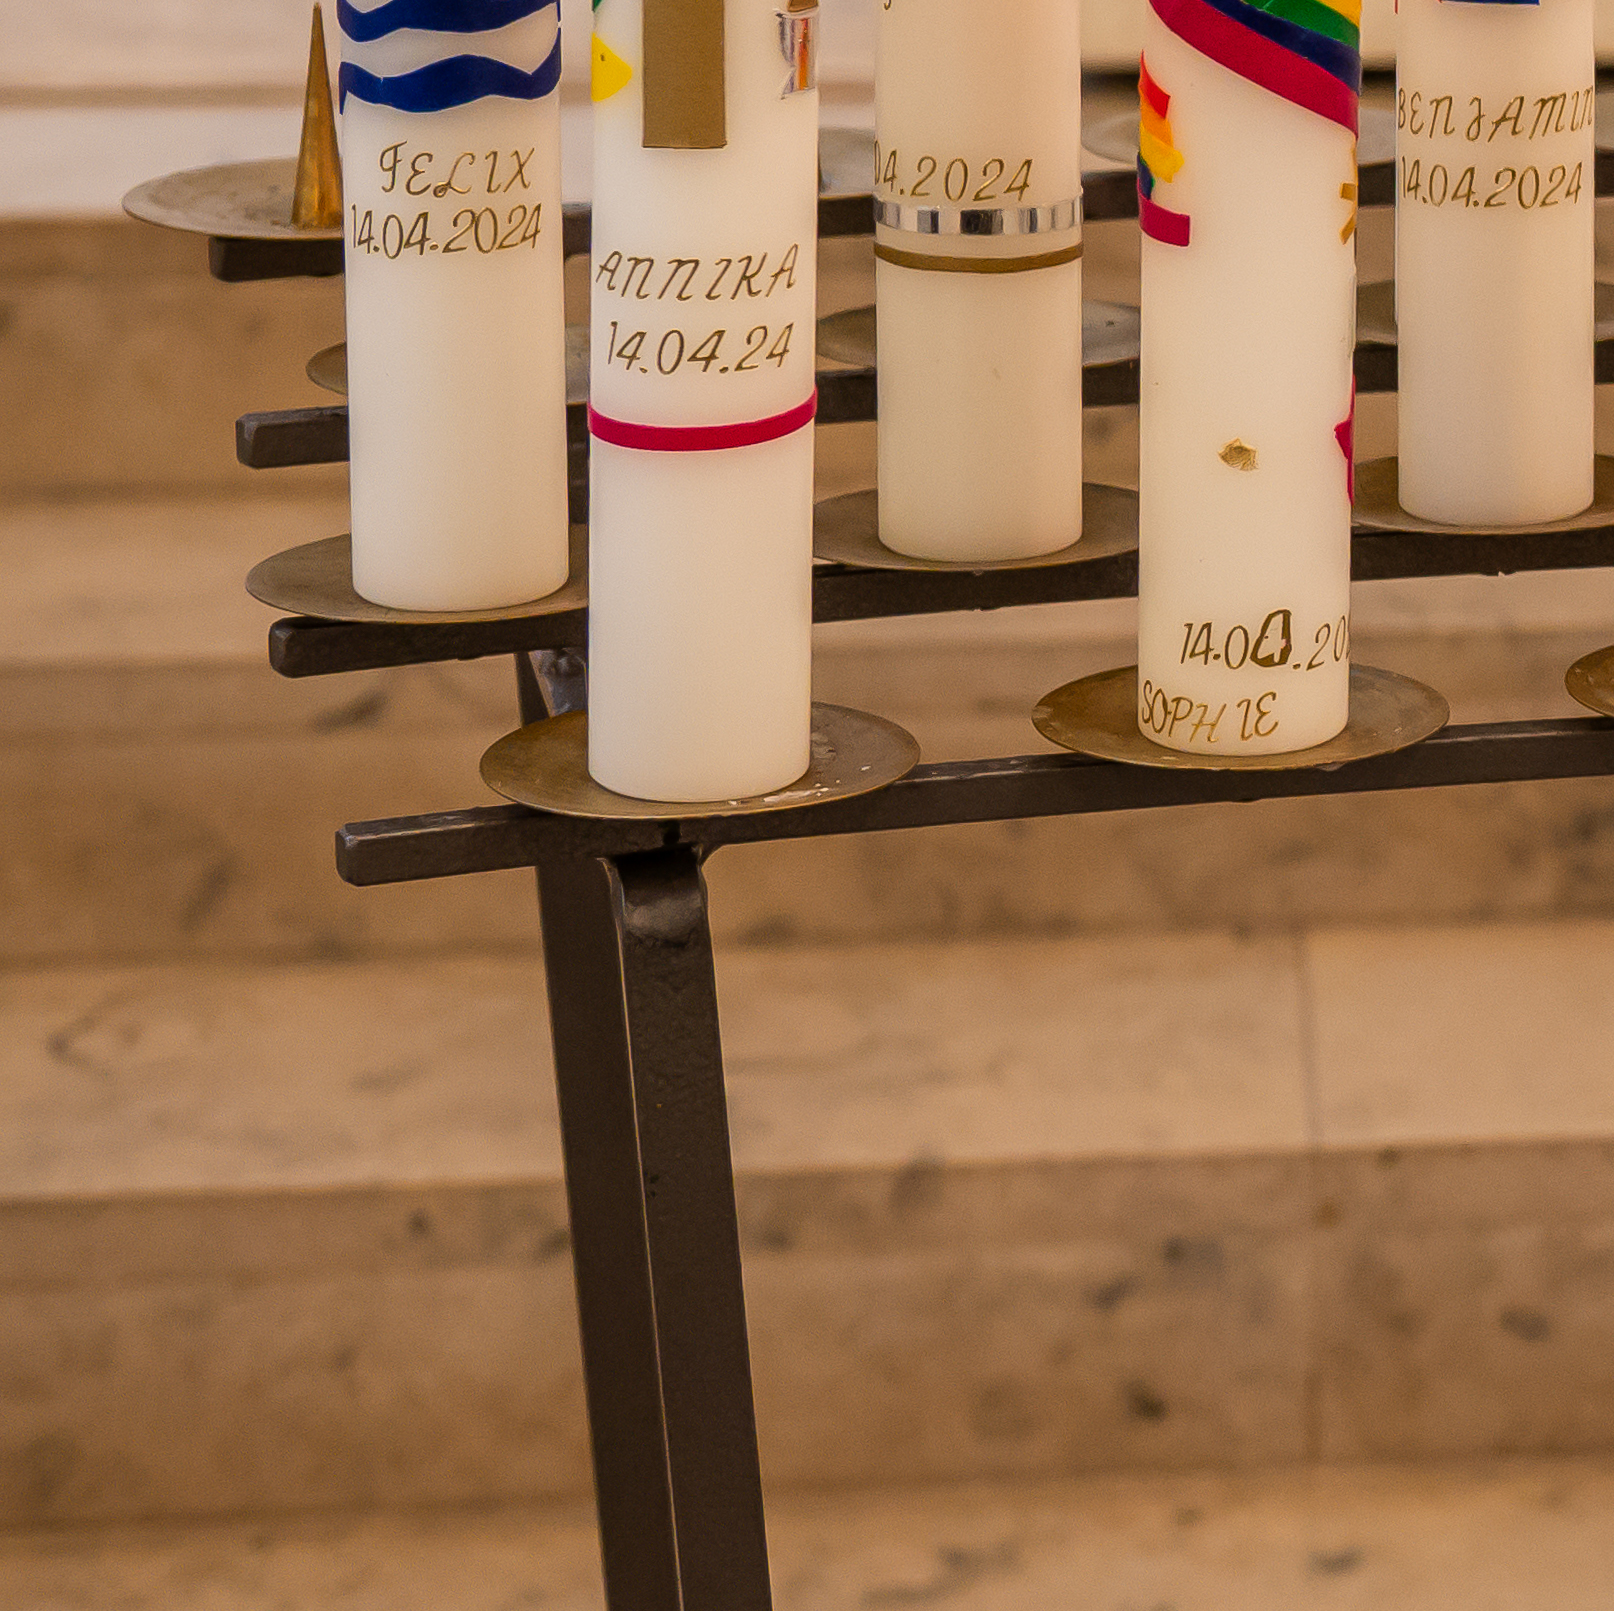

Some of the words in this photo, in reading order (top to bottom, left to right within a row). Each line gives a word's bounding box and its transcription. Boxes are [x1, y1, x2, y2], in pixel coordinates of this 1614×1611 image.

[1398, 85, 1594, 143] BENJAMIN
[379, 139, 535, 198] FELIX
[1402, 155, 1583, 210] 14.04.2024
[351, 202, 542, 260] 14.04.2024
[595, 243, 799, 302] ANNIKA
[607, 320, 795, 376] 14.04.24
[1180, 608, 1350, 672] 14.04.20
[1141, 679, 1279, 744] SOPHIE
